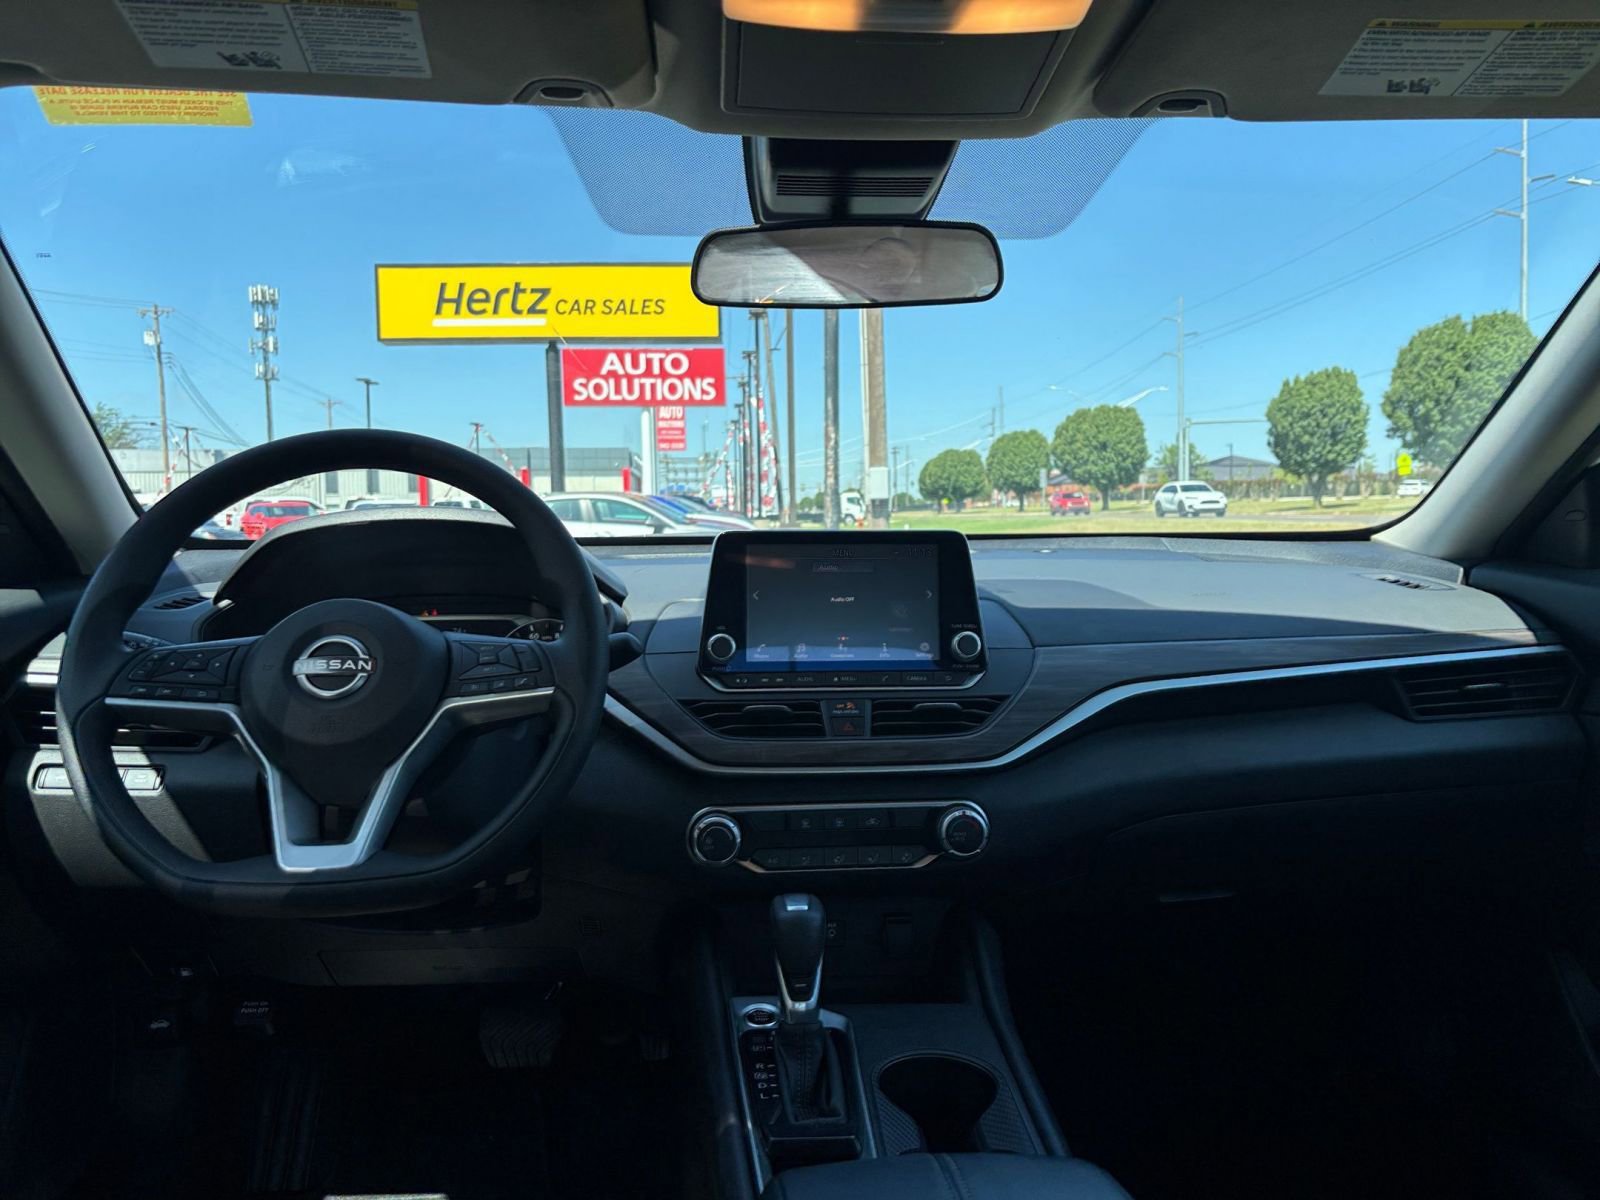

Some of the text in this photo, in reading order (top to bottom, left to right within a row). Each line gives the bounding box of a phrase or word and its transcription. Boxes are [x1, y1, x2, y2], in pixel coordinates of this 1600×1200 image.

[434, 282, 666, 316] Hertz CAR SALES
[600, 352, 689, 376] AUTO
[573, 377, 716, 401] SOLUTIONS
[659, 406, 683, 419] AUTO
[295, 660, 372, 670] NISSAN
